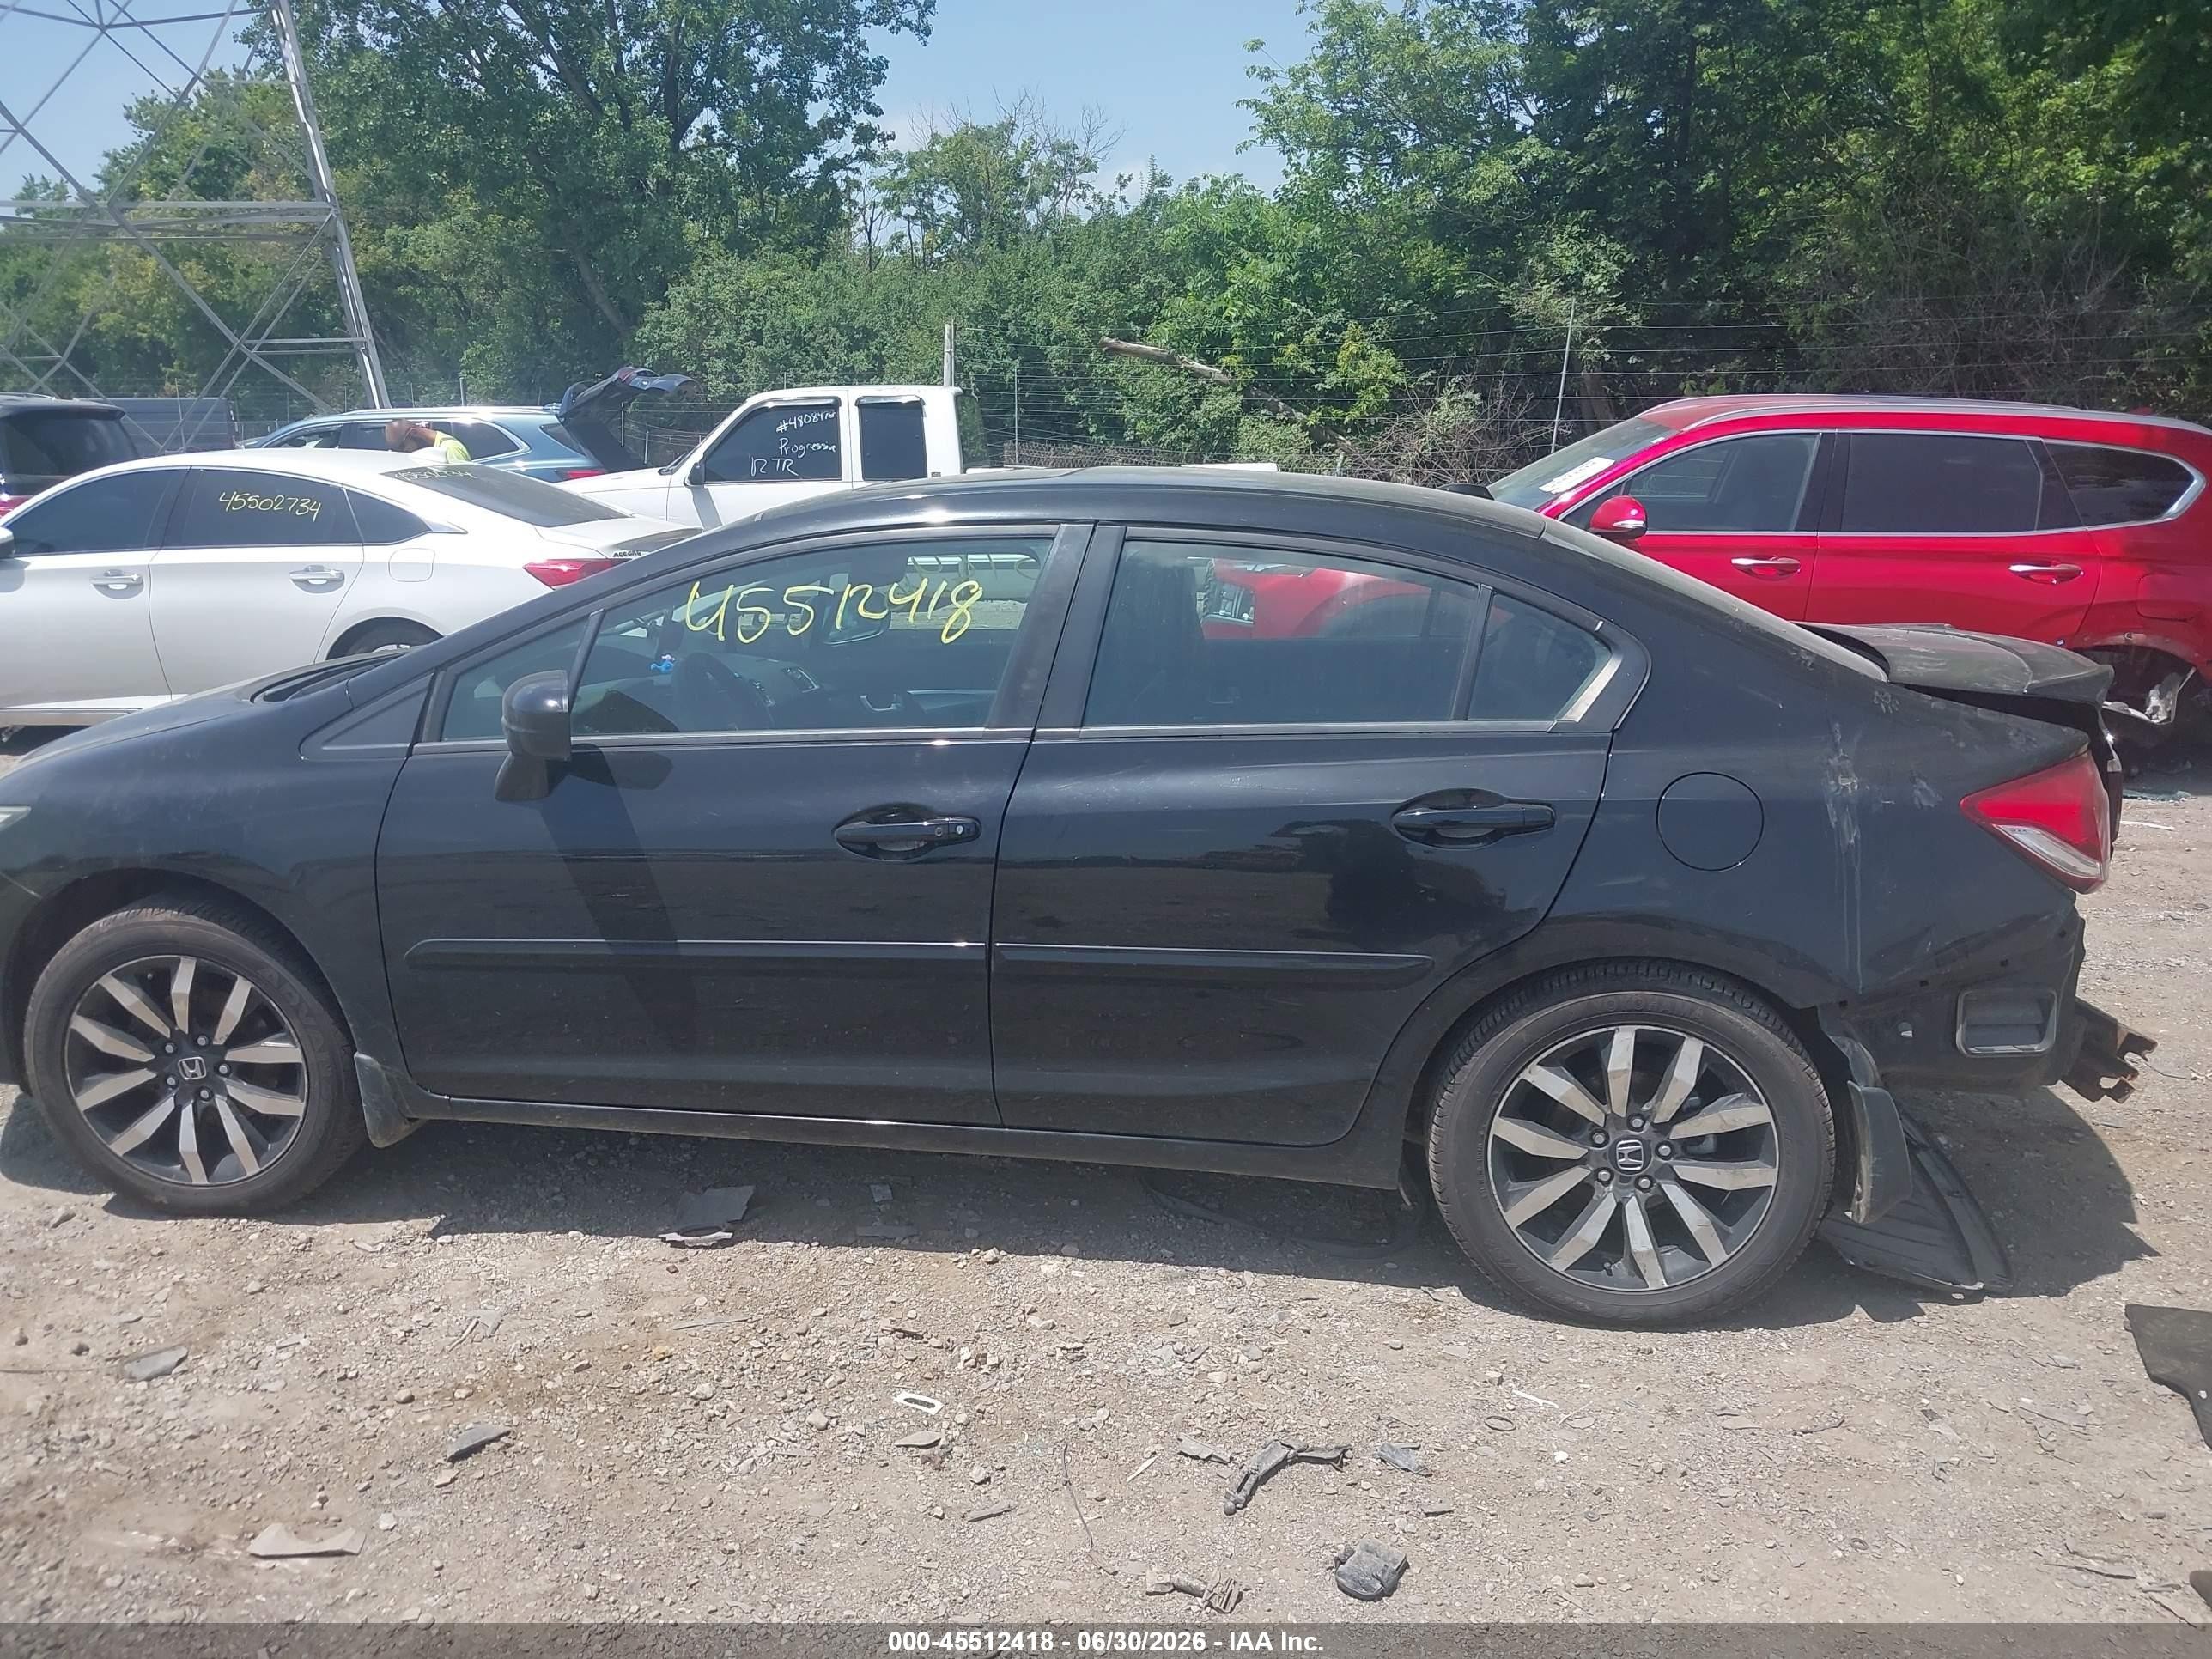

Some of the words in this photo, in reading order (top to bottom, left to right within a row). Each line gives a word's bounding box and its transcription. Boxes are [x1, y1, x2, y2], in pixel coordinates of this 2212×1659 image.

[779, 437, 836, 459] Progressive
[218, 490, 322, 523] 45502734
[685, 577, 984, 645] 45512418
